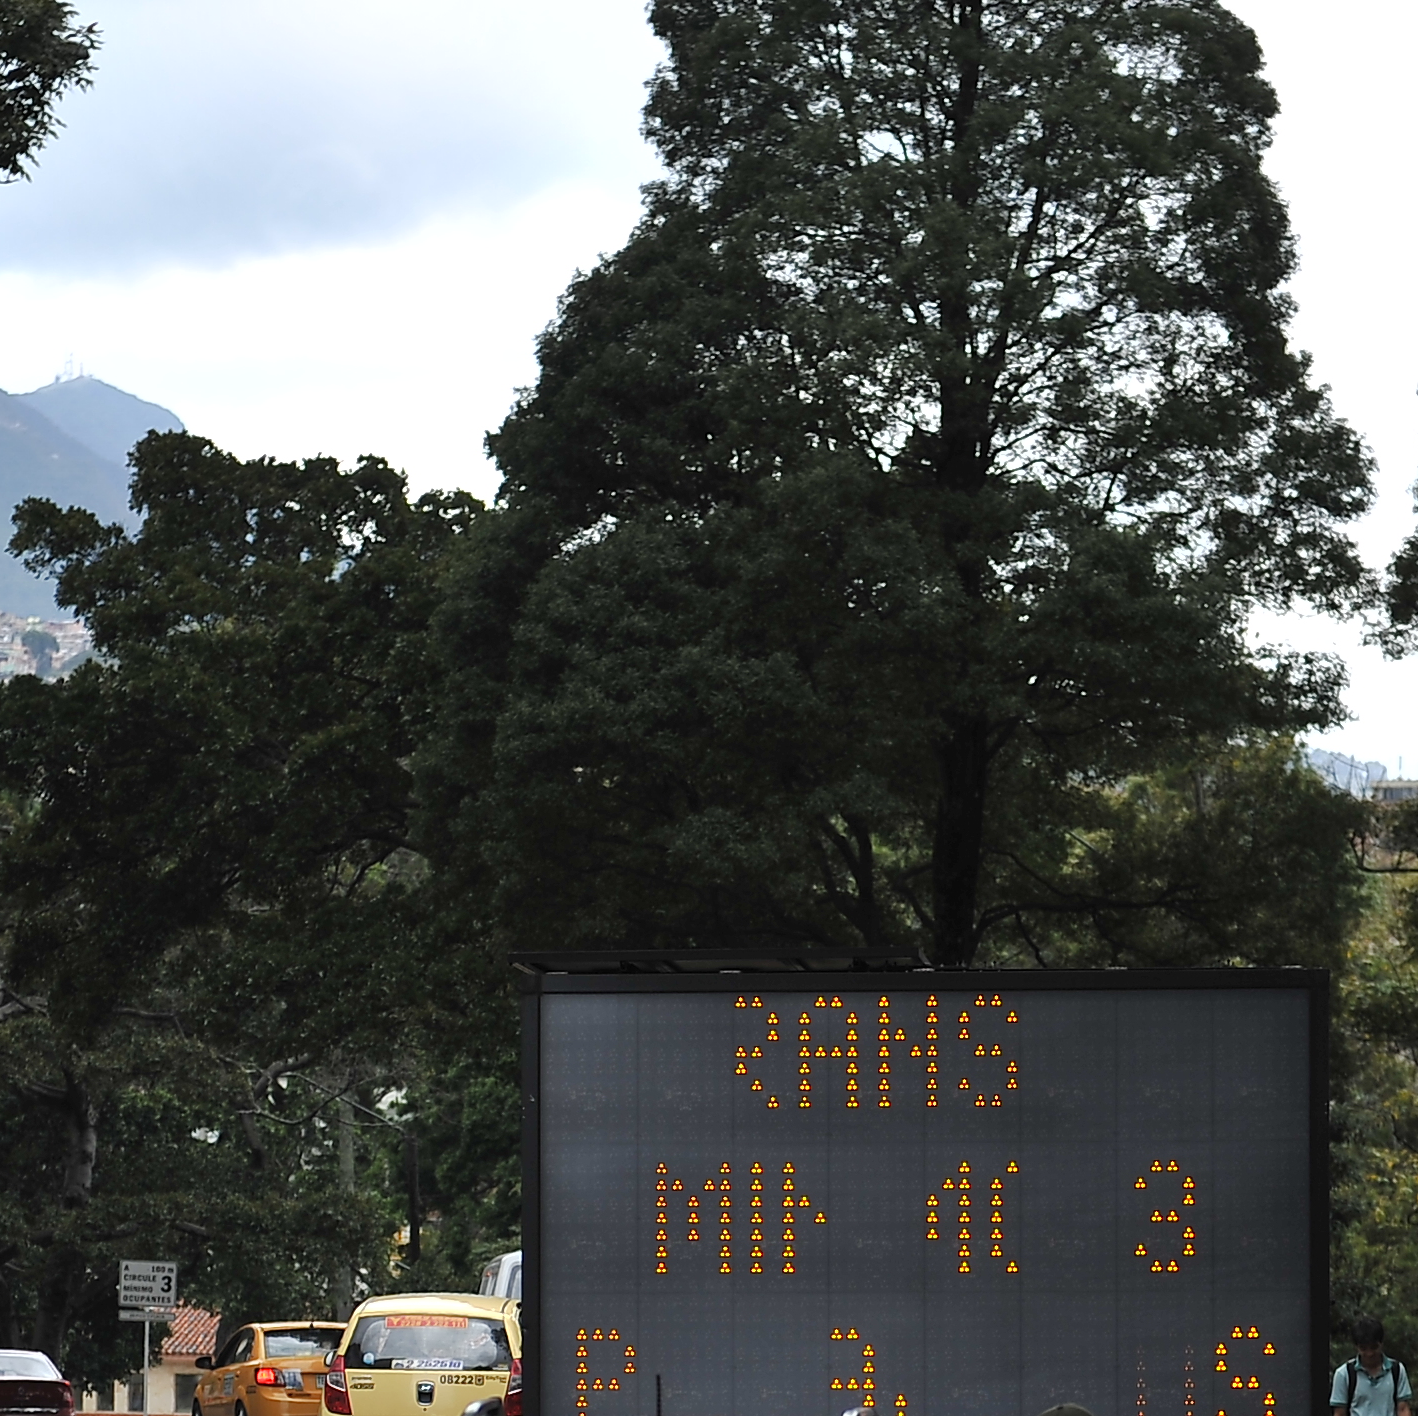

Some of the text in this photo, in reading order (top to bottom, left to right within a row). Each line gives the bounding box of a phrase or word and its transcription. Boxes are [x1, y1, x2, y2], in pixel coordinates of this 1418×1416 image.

[123, 1274, 157, 1282] CIRCULE
[161, 1275, 172, 1293] 3
[123, 1295, 171, 1303] OCUPANTES
